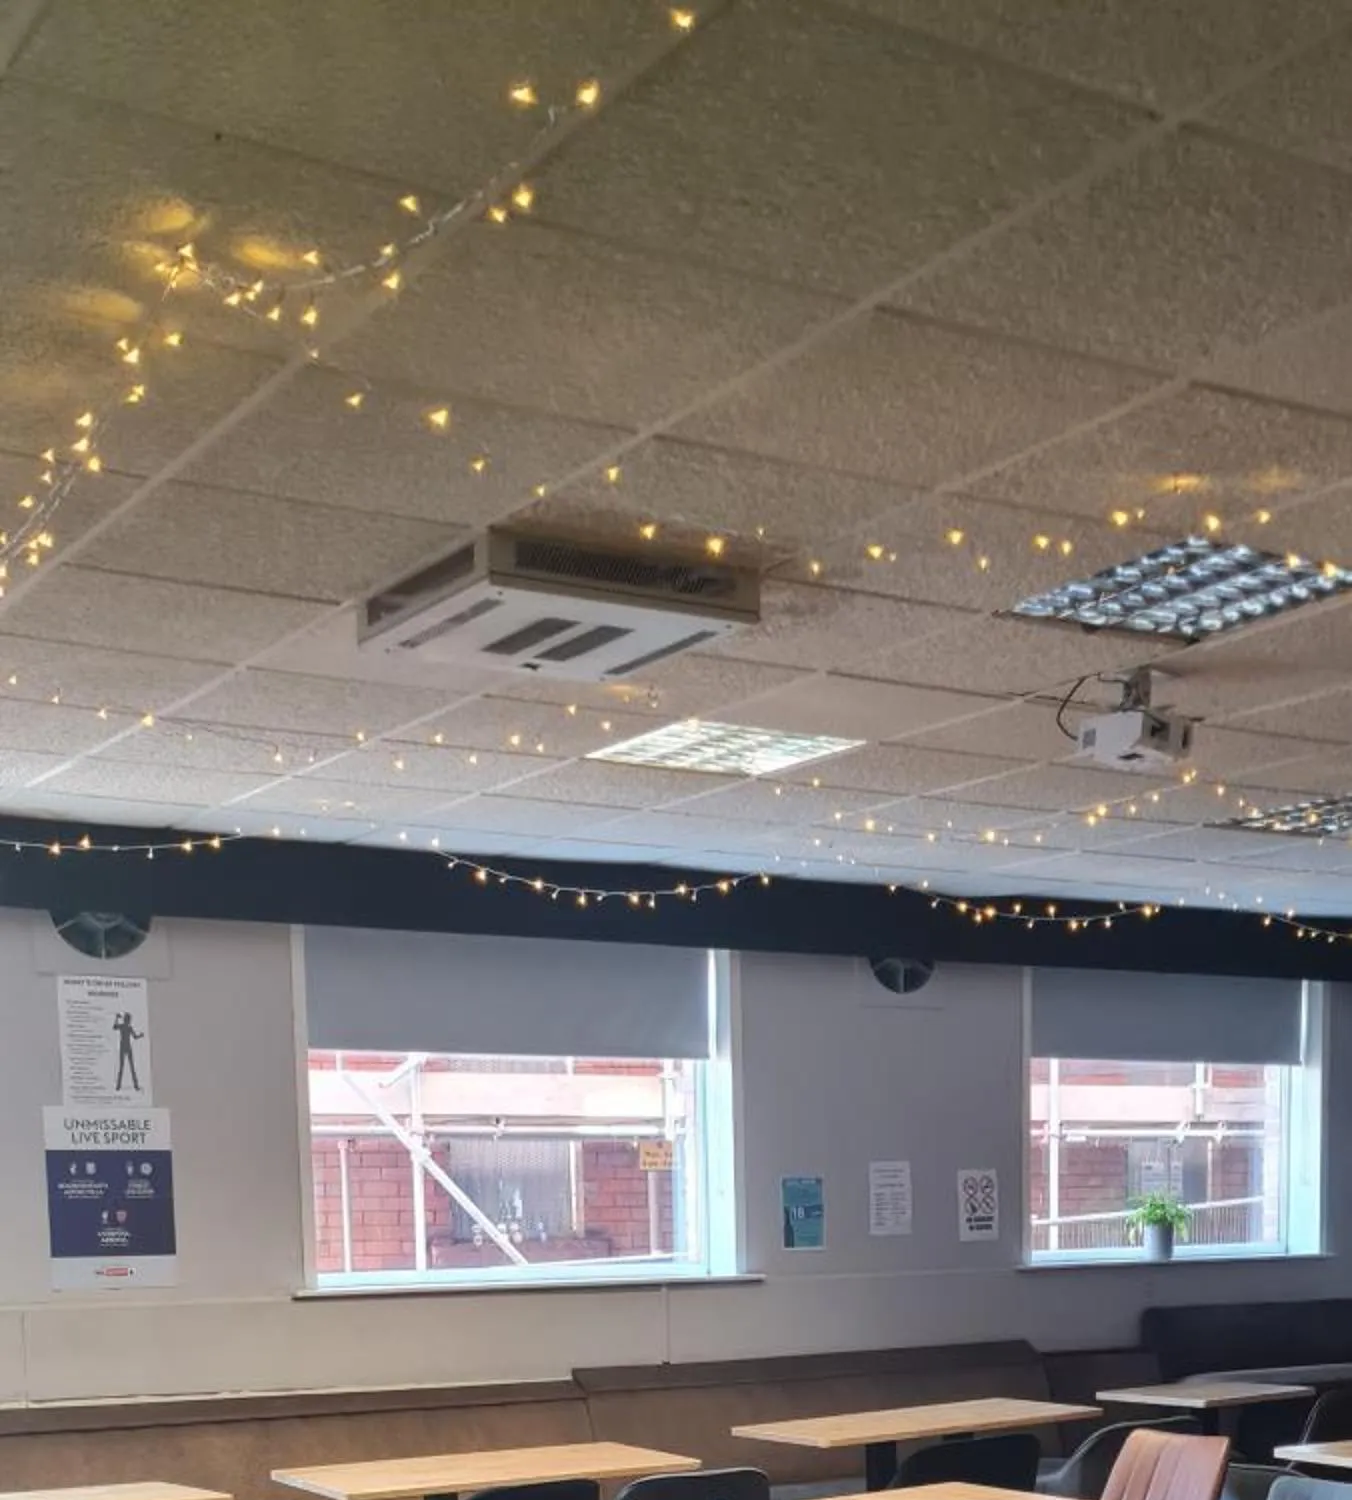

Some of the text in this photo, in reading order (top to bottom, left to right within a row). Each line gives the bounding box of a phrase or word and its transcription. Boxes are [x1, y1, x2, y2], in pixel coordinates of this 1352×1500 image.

[63, 1118, 152, 1131] UNMISSABLE
[71, 1131, 146, 1144] LIVE SPORT
